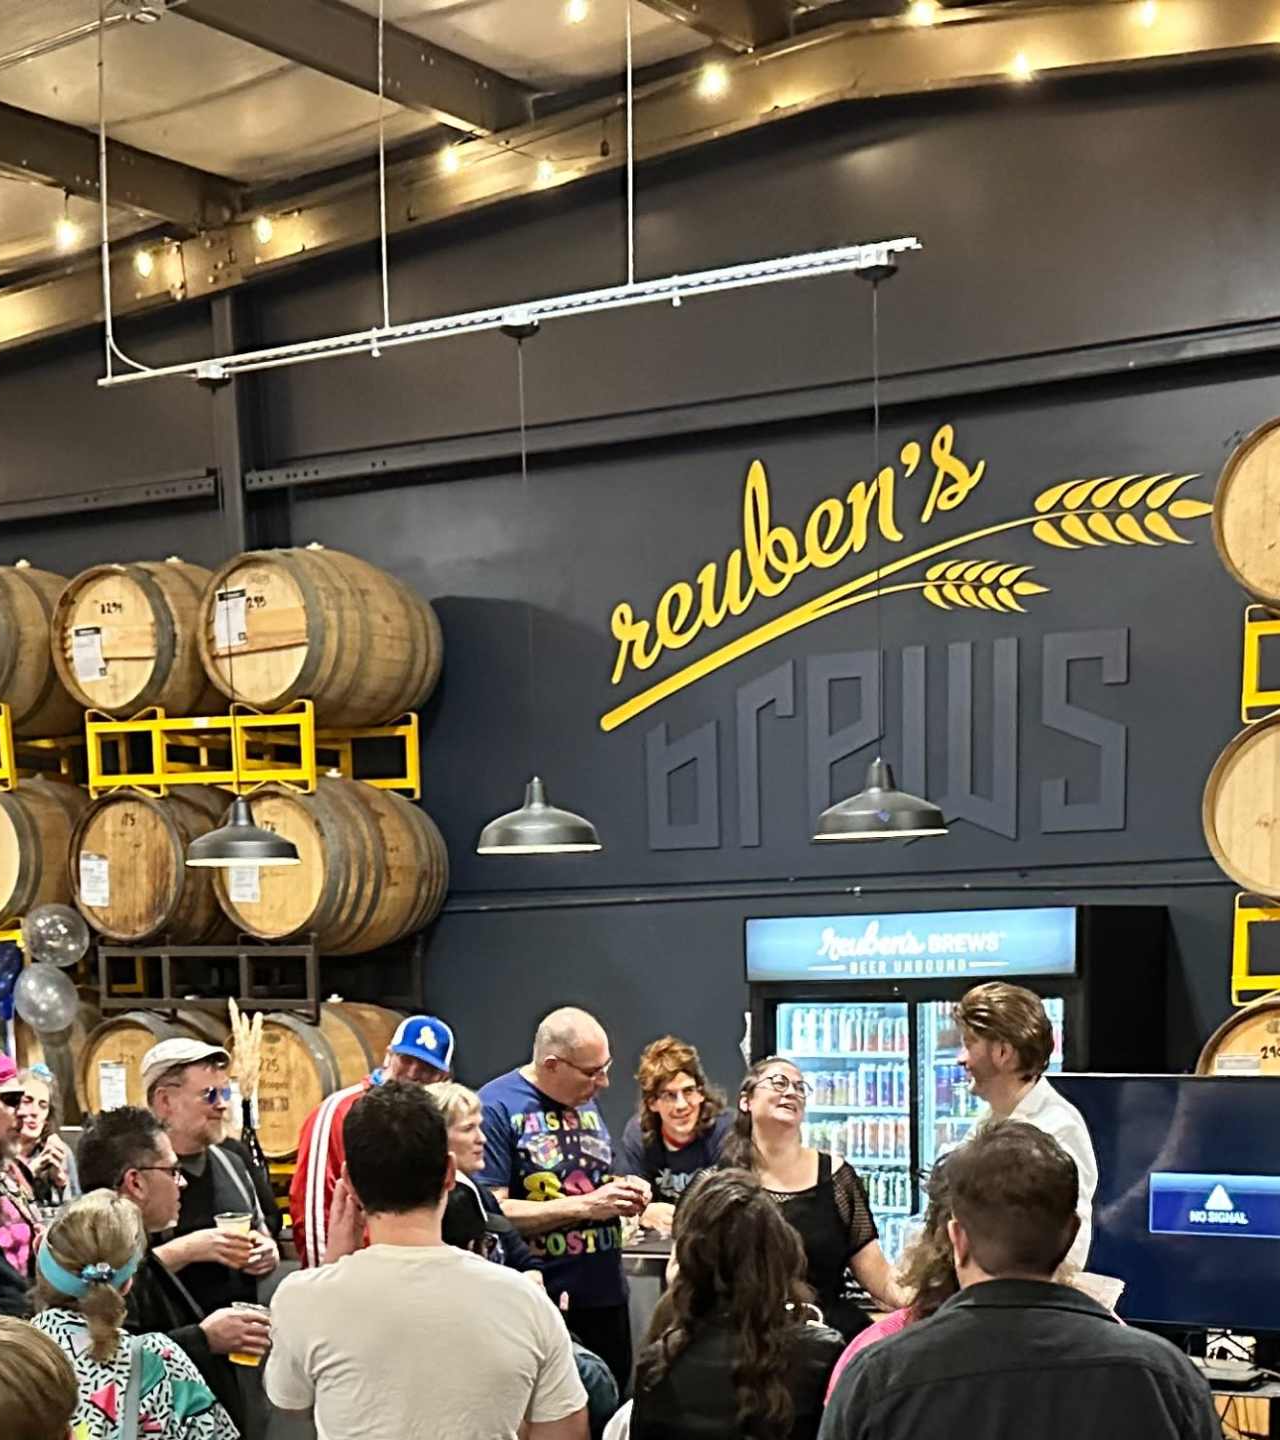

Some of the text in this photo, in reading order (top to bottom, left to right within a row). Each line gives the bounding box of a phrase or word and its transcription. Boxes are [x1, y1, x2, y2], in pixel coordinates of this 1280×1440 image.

[610, 424, 985, 684] reuben's
[927, 931, 1000, 953] BREWS
[849, 959, 967, 975] BEER UNBOUND
[511, 1111, 560, 1134] THIS
[1189, 1210, 1249, 1226] NO SIGNAL
